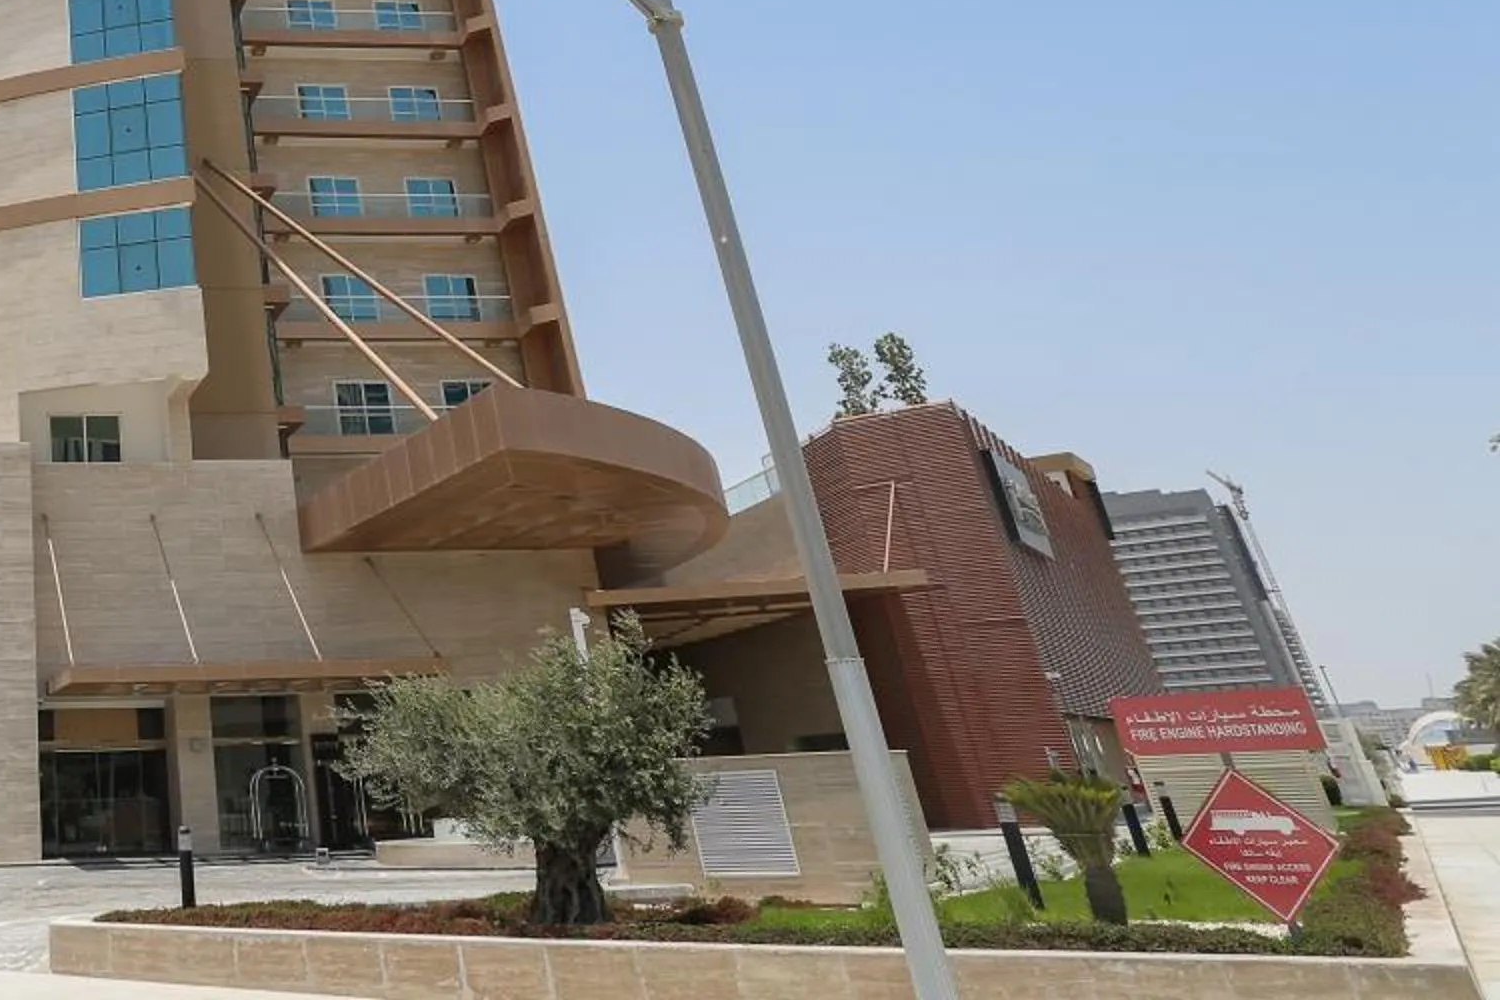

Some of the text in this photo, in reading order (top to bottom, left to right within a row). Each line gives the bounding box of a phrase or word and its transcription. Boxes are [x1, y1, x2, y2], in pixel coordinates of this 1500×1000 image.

[1129, 721, 1307, 742] FIRE ENGINE HARDSTANDING
